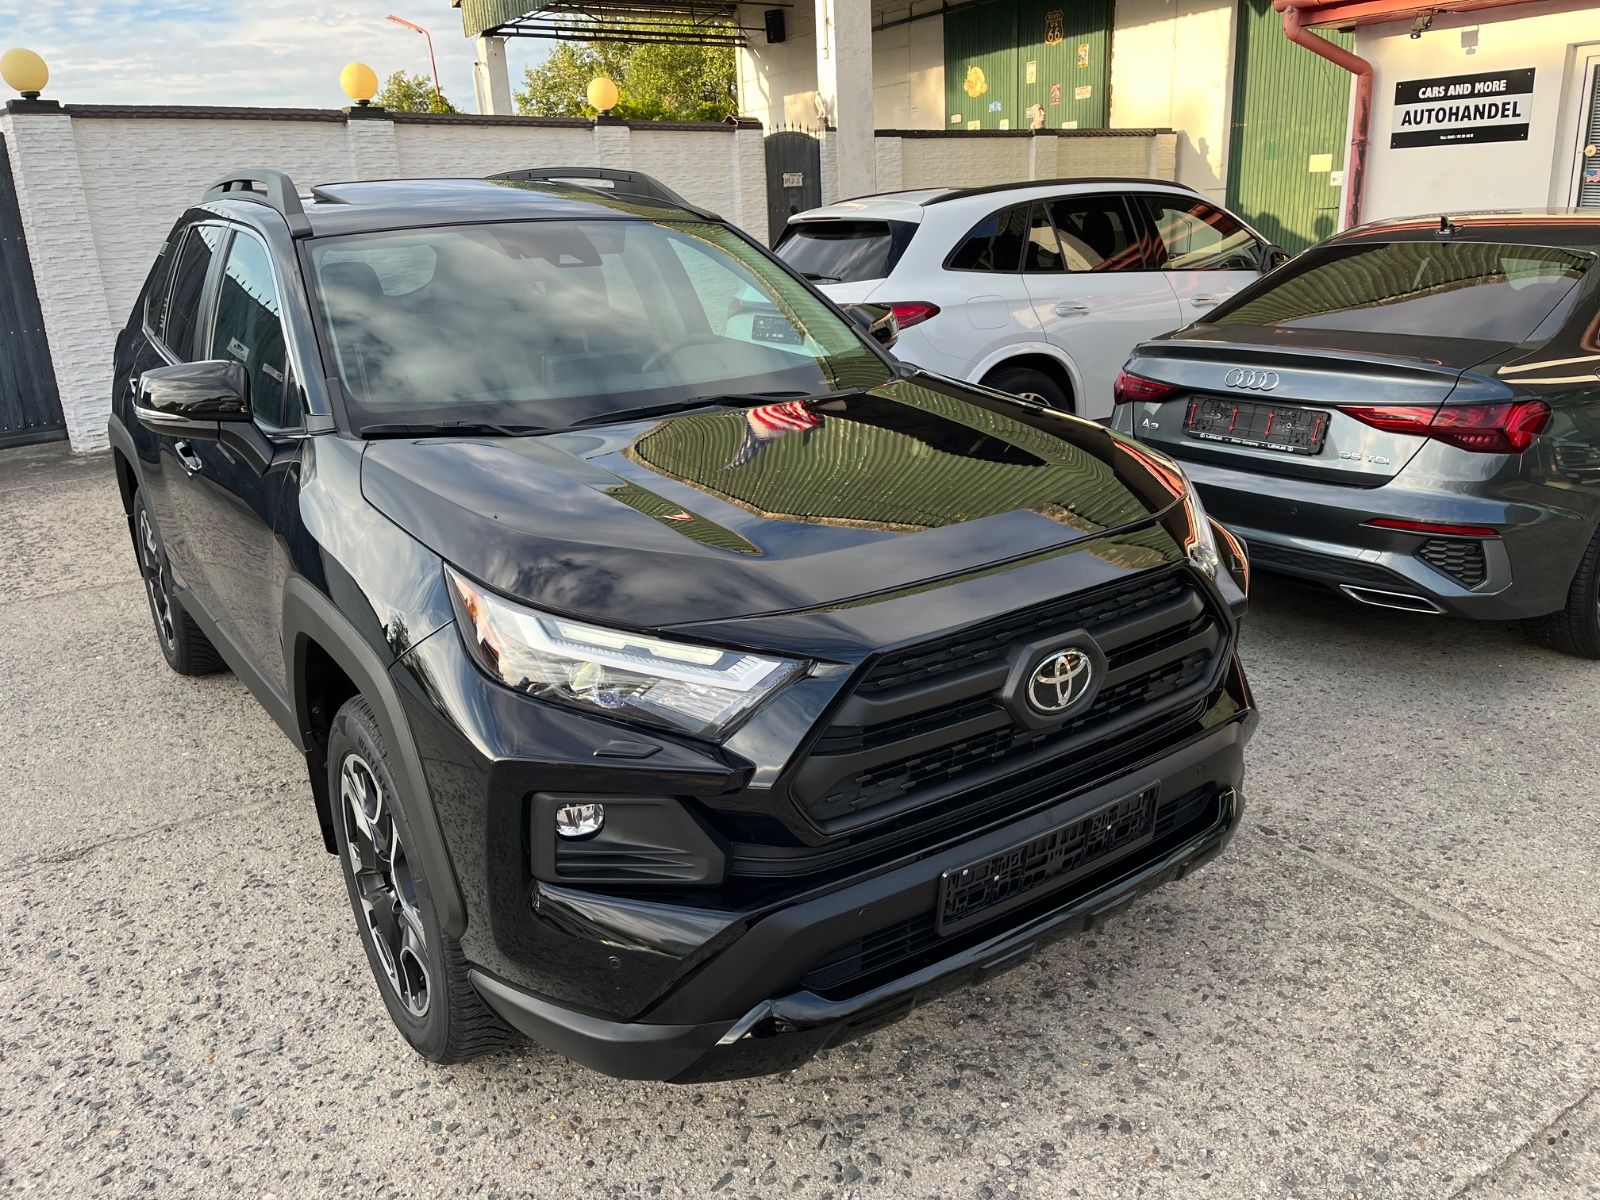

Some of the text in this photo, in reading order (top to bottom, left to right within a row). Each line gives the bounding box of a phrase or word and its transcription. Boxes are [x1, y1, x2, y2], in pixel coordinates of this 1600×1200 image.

[1048, 27, 1060, 41] 66
[1418, 79, 1507, 99] CARS AND MORE
[1401, 101, 1521, 126] AUTOHANDEL
[1142, 417, 1159, 430] A3
[1366, 454, 1390, 465] TDI
